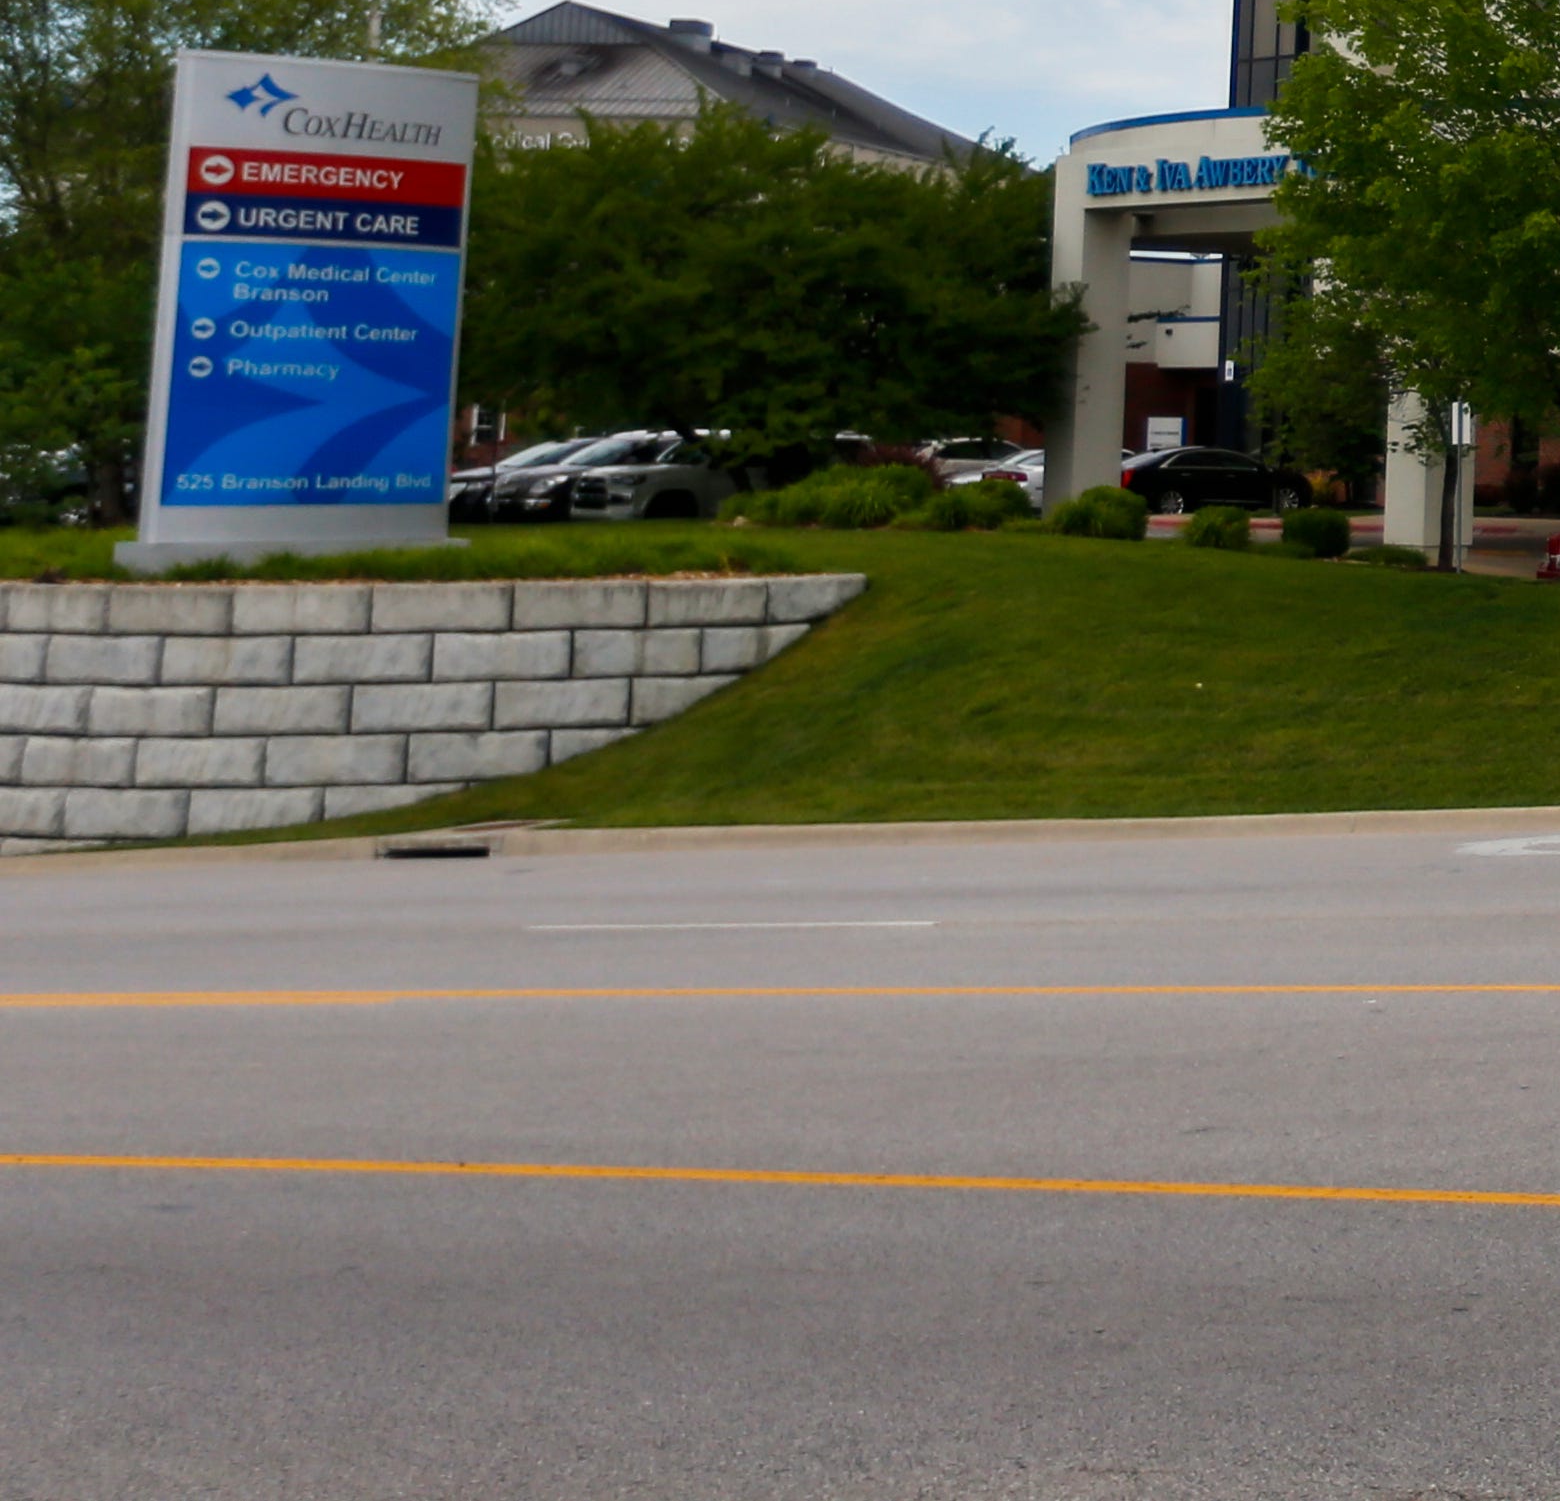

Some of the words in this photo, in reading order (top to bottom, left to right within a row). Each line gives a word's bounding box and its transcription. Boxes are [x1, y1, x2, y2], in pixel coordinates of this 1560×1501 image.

[241, 161, 404, 190] EMERGENCY
[1136, 164, 1152, 192] &
[238, 207, 349, 232] URGENT
[355, 212, 420, 235] CARE
[235, 260, 280, 279] Cox
[287, 263, 371, 283] Medical
[376, 267, 437, 285] Center
[233, 282, 330, 302] Branson
[229, 319, 348, 343] Outpatient
[354, 323, 418, 342] Center
[226, 357, 340, 380] Pharmacy
[176, 473, 214, 490] 525
[221, 473, 309, 491] Branson
[316, 473, 390, 492] Landing
[396, 473, 432, 488] Blvd
